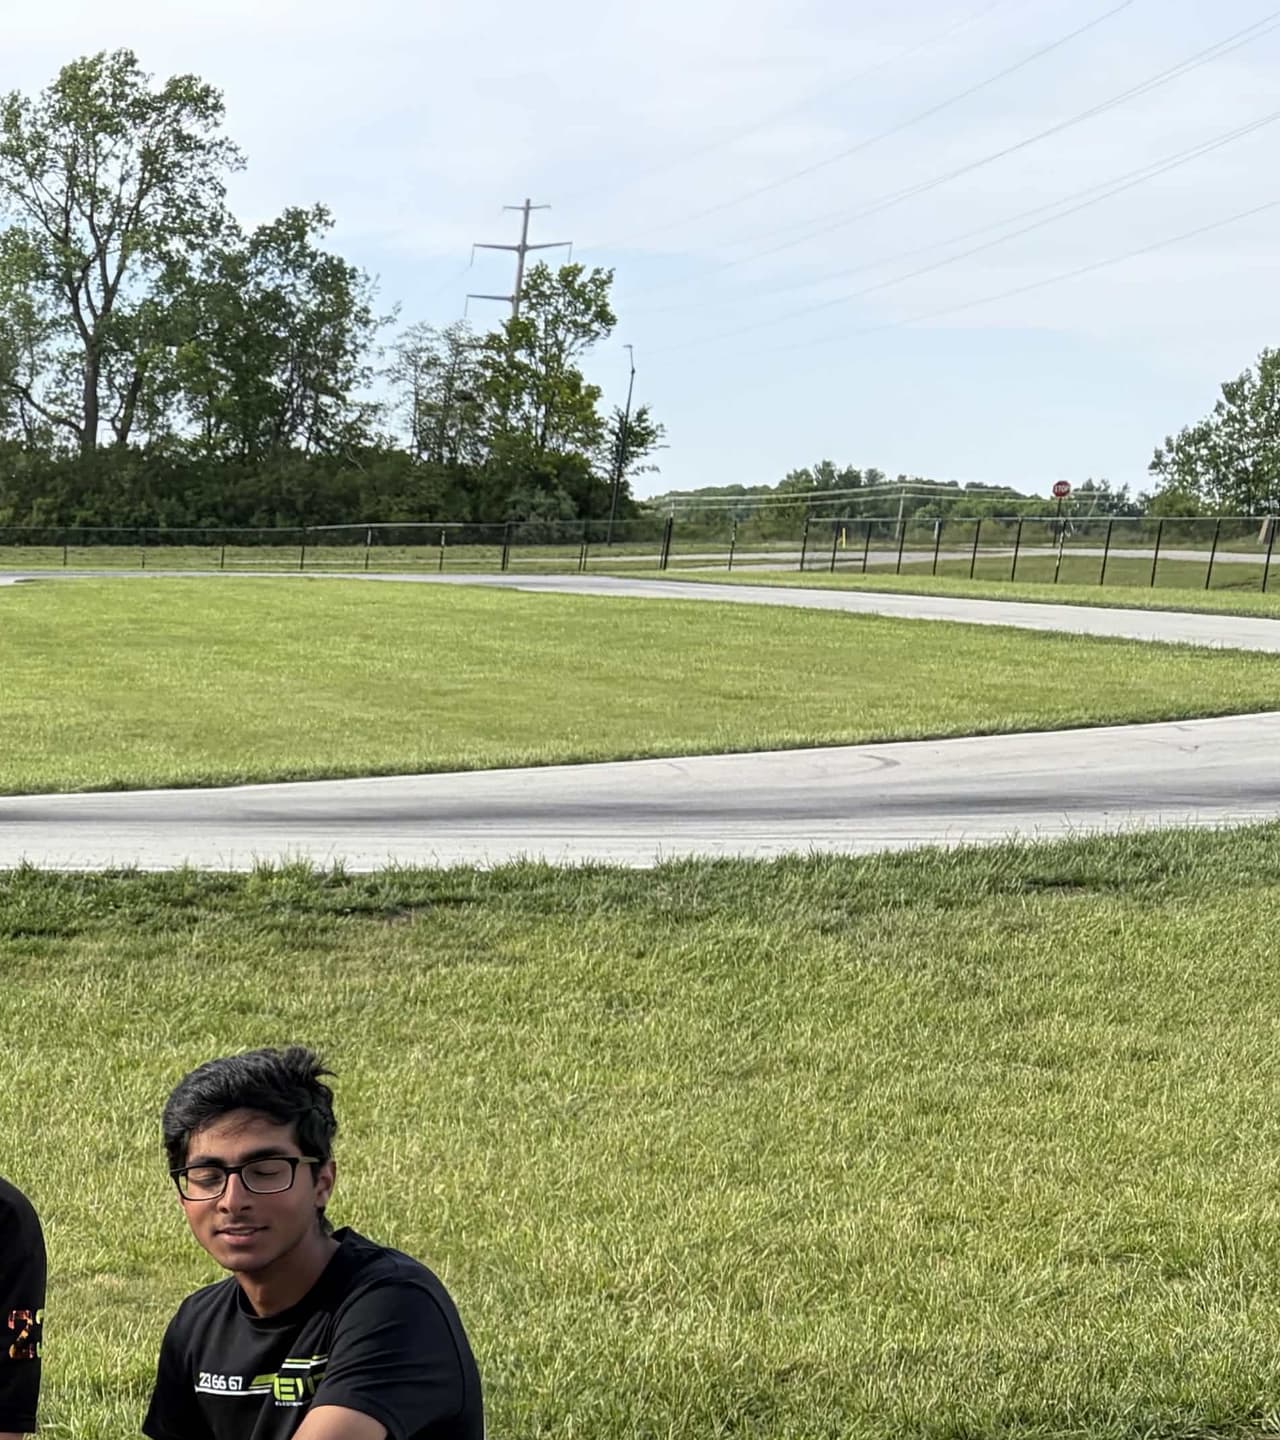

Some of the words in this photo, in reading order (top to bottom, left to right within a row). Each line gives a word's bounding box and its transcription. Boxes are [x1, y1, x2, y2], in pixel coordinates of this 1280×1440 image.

[199, 1372, 211, 1387] 23
[212, 1375, 226, 1390] 66
[228, 1375, 243, 1390] 67
